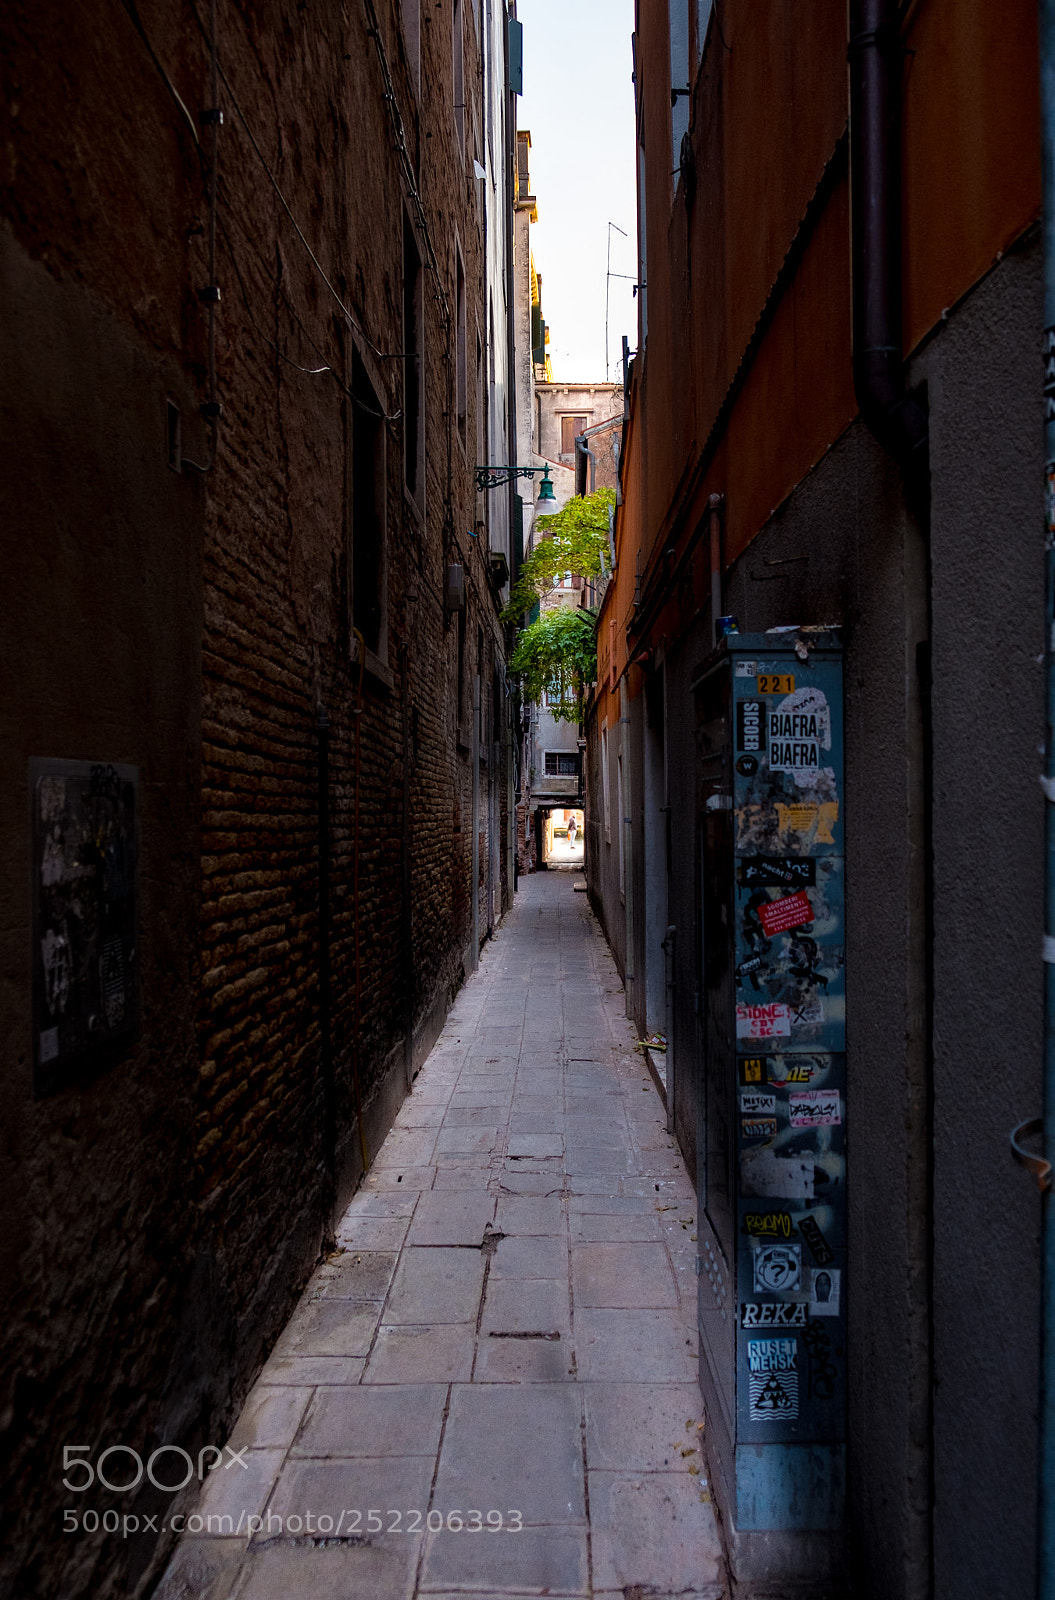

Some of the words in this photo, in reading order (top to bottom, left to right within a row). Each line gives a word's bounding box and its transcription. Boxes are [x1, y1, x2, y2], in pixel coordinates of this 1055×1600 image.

[760, 676, 792, 692] 221
[770, 714, 817, 737] BIAFRA
[771, 743, 817, 766] BIAFRA
[742, 1303, 807, 1324] REKA
